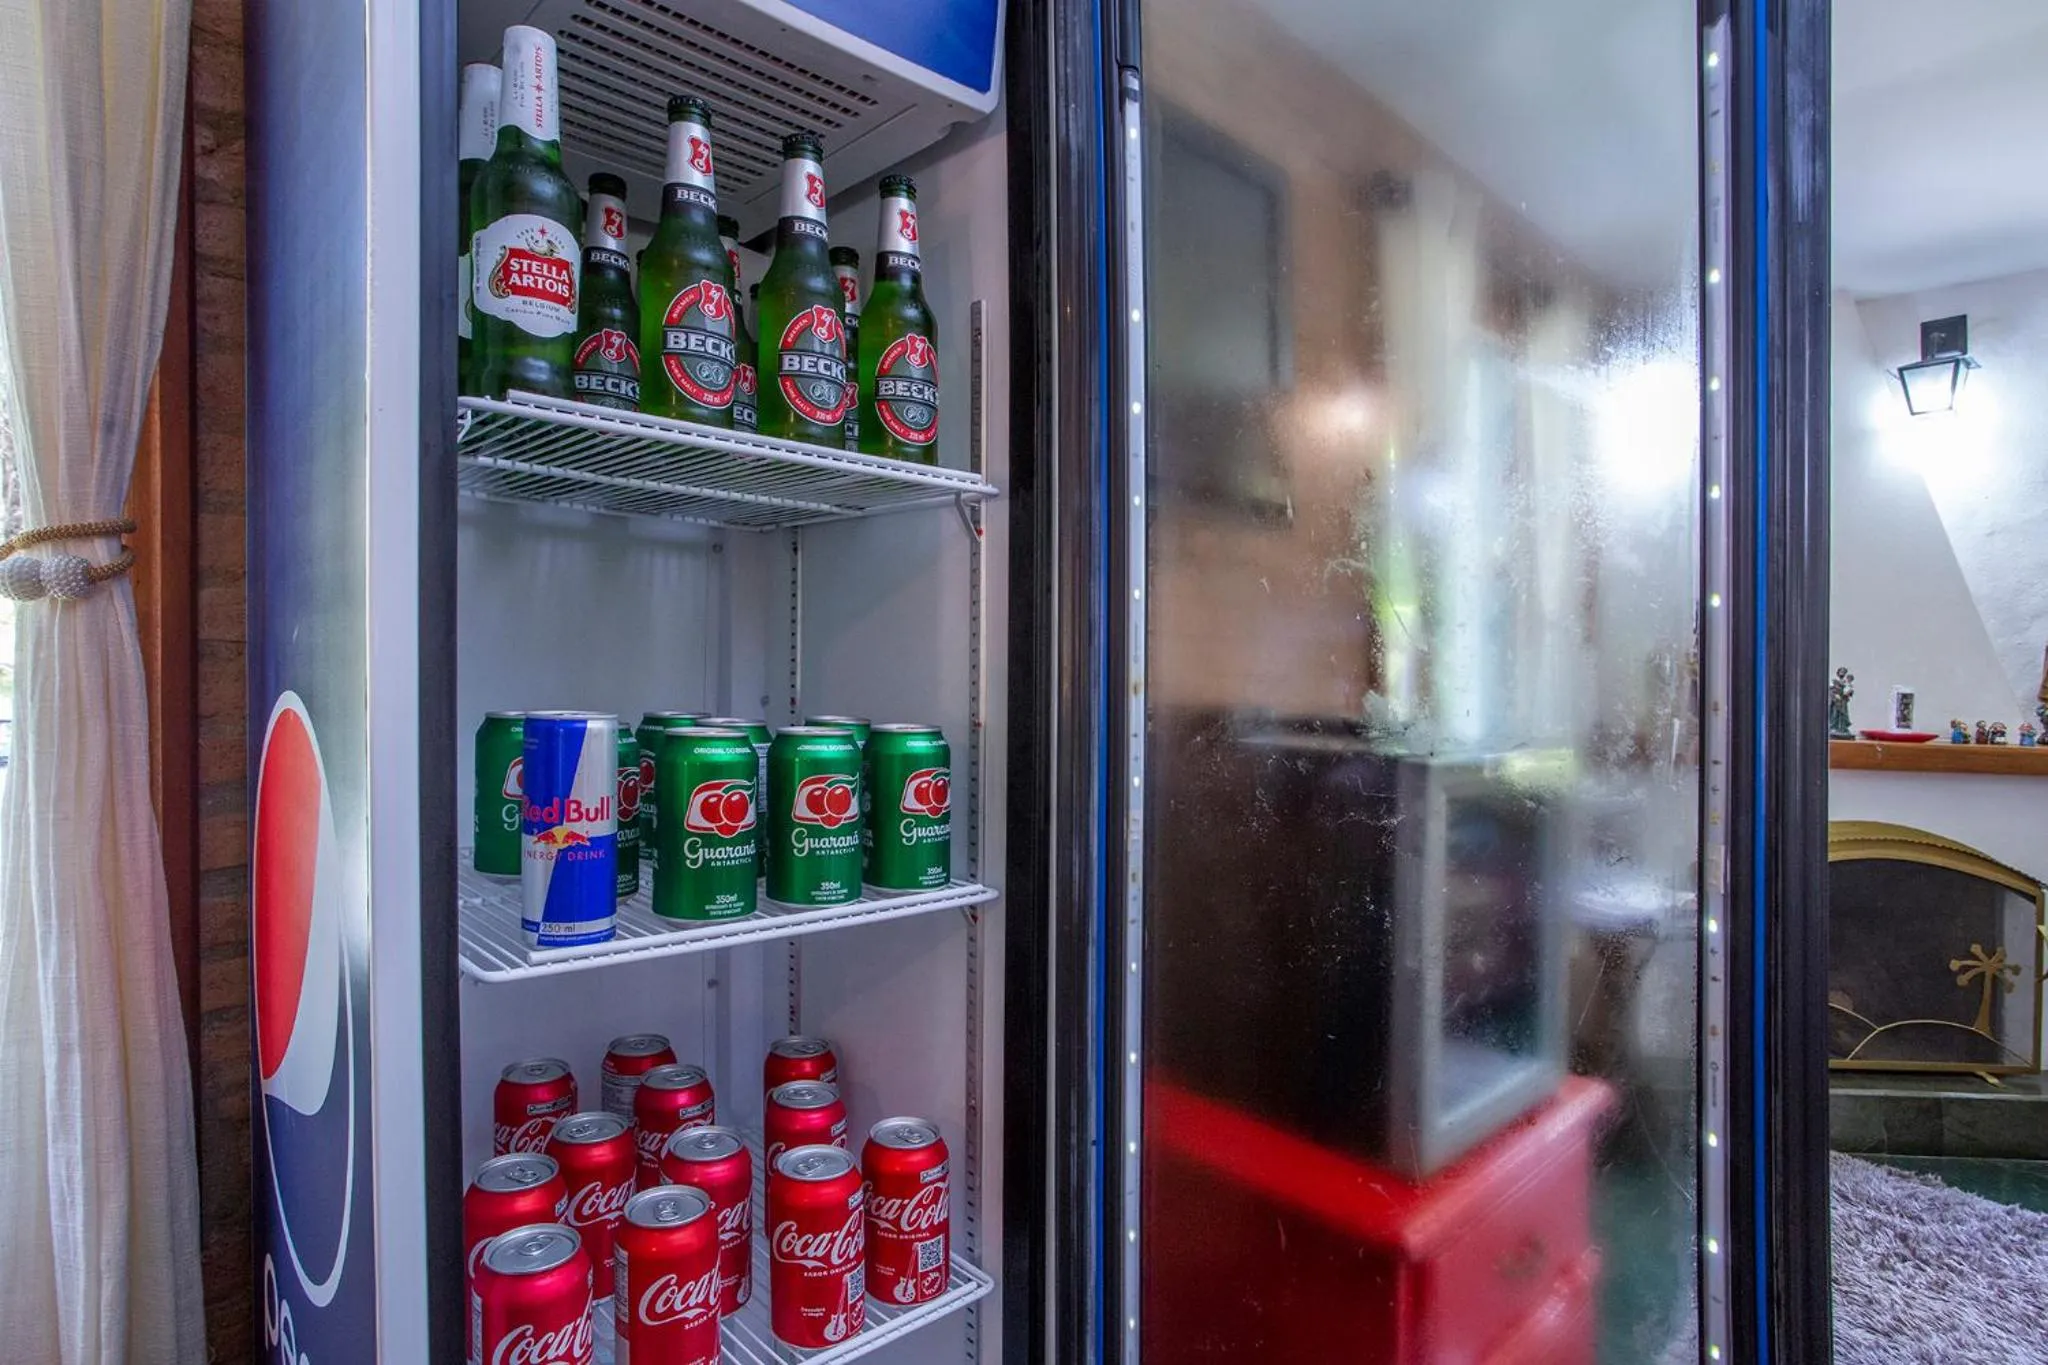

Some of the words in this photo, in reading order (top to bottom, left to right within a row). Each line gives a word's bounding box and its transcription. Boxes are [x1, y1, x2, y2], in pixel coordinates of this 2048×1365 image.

[535, 45, 543, 82] ARTOIS
[535, 96, 543, 129] STELLA
[509, 257, 570, 284] STELLA
[508, 272, 570, 298] ARTOIS
[564, 797, 610, 823] Bull
[567, 849, 606, 861] DRINK
[684, 837, 756, 869] Guaraná
[791, 827, 860, 857] Guaraná
[541, 923, 560, 933] 250
[564, 923, 576, 933] ml
